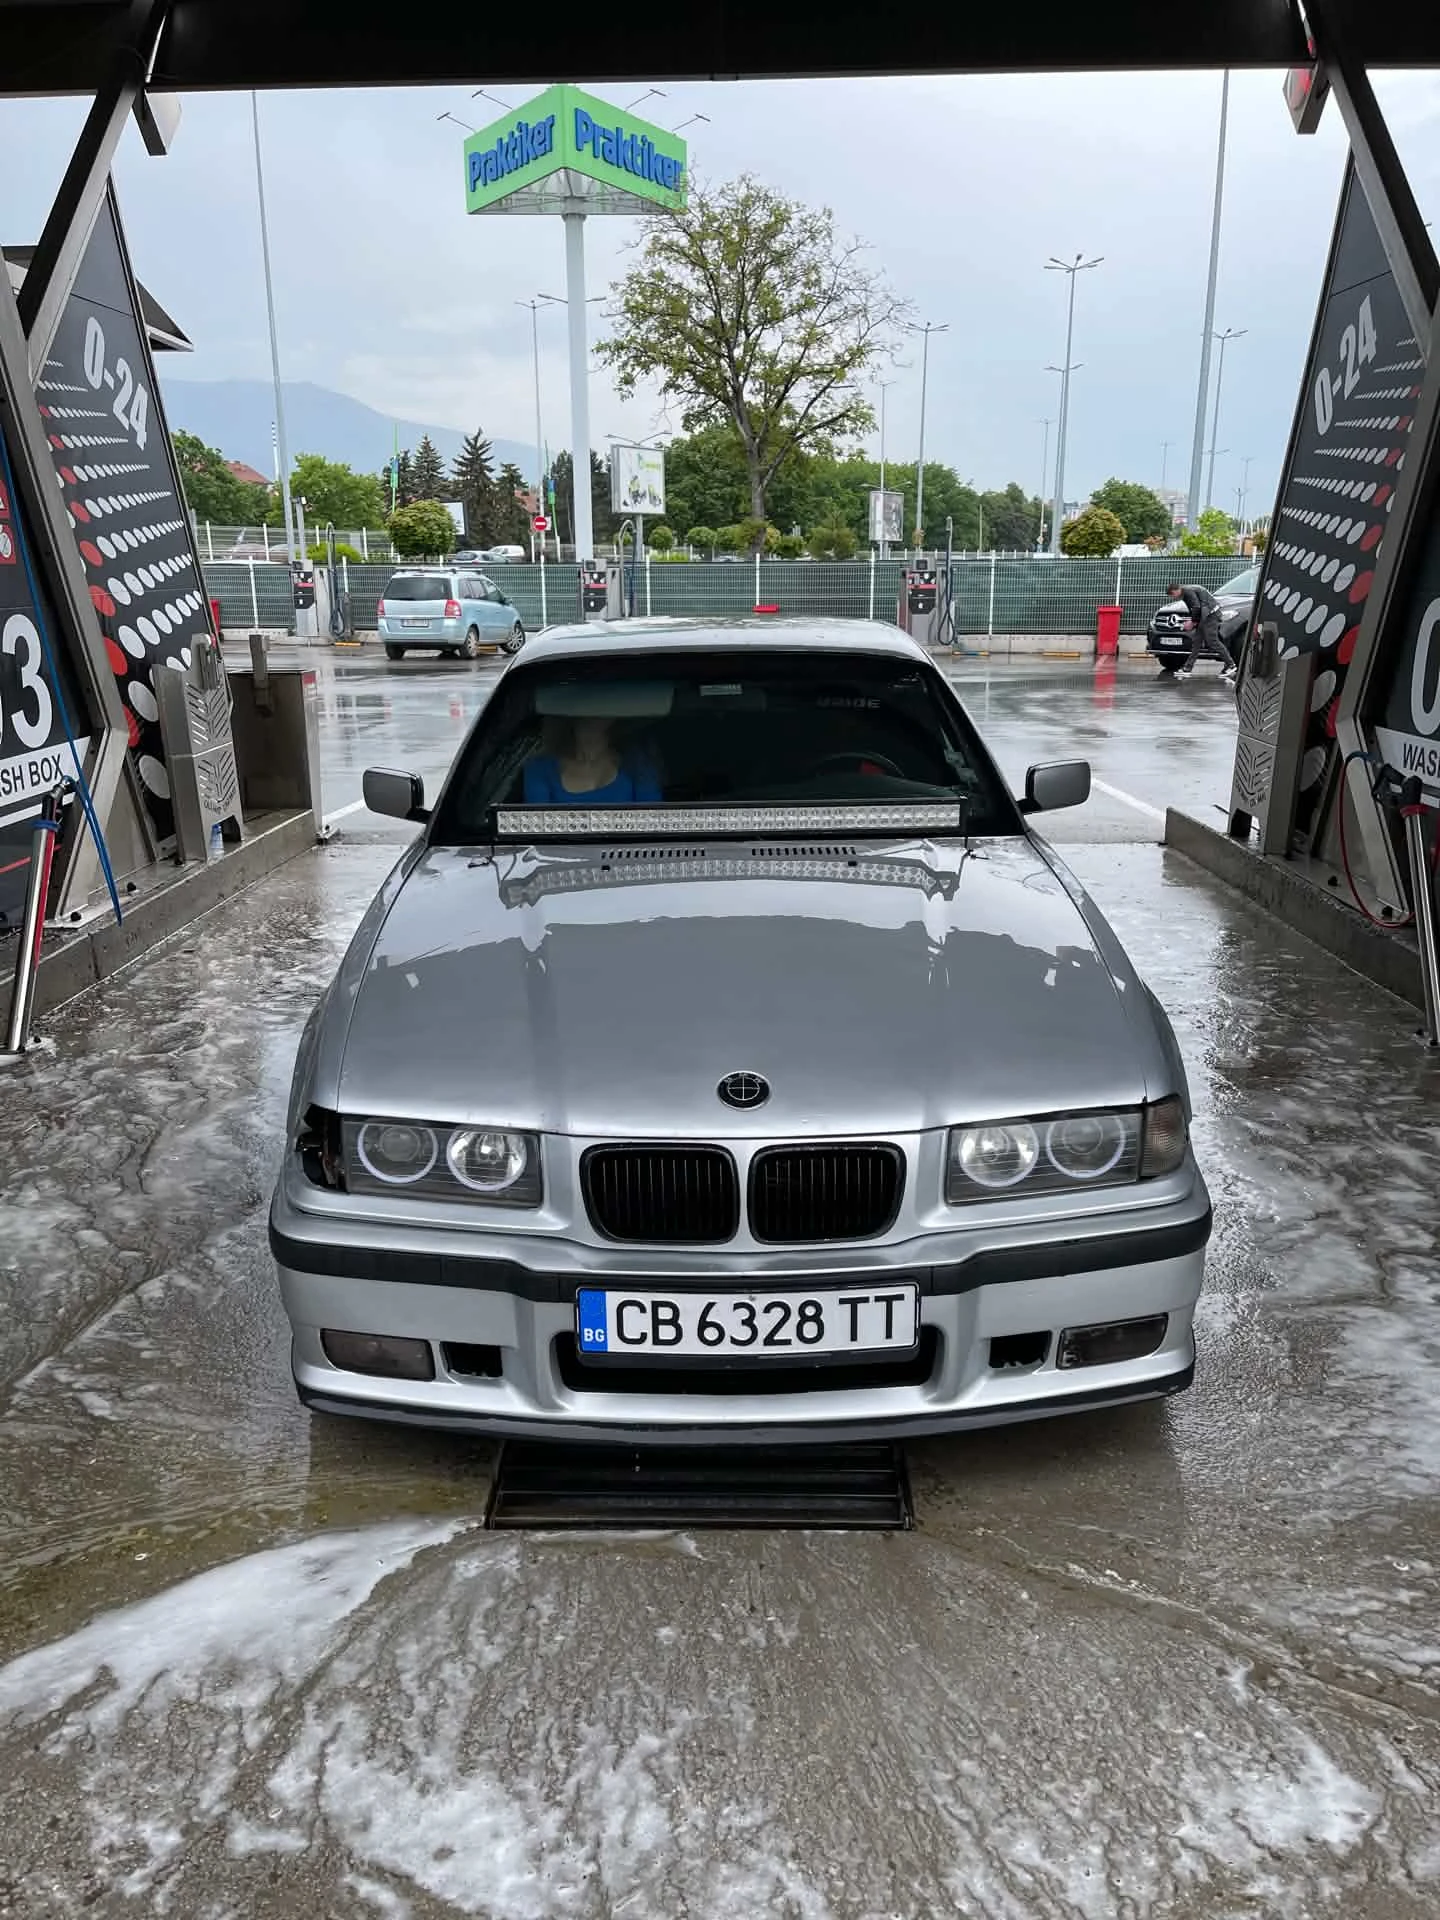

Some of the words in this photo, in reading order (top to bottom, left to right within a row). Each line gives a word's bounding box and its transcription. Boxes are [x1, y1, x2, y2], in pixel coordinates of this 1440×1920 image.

[469, 114, 555, 192] Praktiker
[574, 107, 684, 192] Praktiker
[84, 316, 149, 451] 0-24
[1314, 294, 1377, 436] 0-24
[0, 614, 52, 748] 3
[0, 764, 25, 797] SH
[28, 753, 63, 787] BOX
[1403, 743, 1440, 778] WAS
[583, 1327, 605, 1343] BG
[616, 1299, 684, 1346] CB
[696, 1299, 825, 1347] 6328
[838, 1293, 905, 1342] TT
